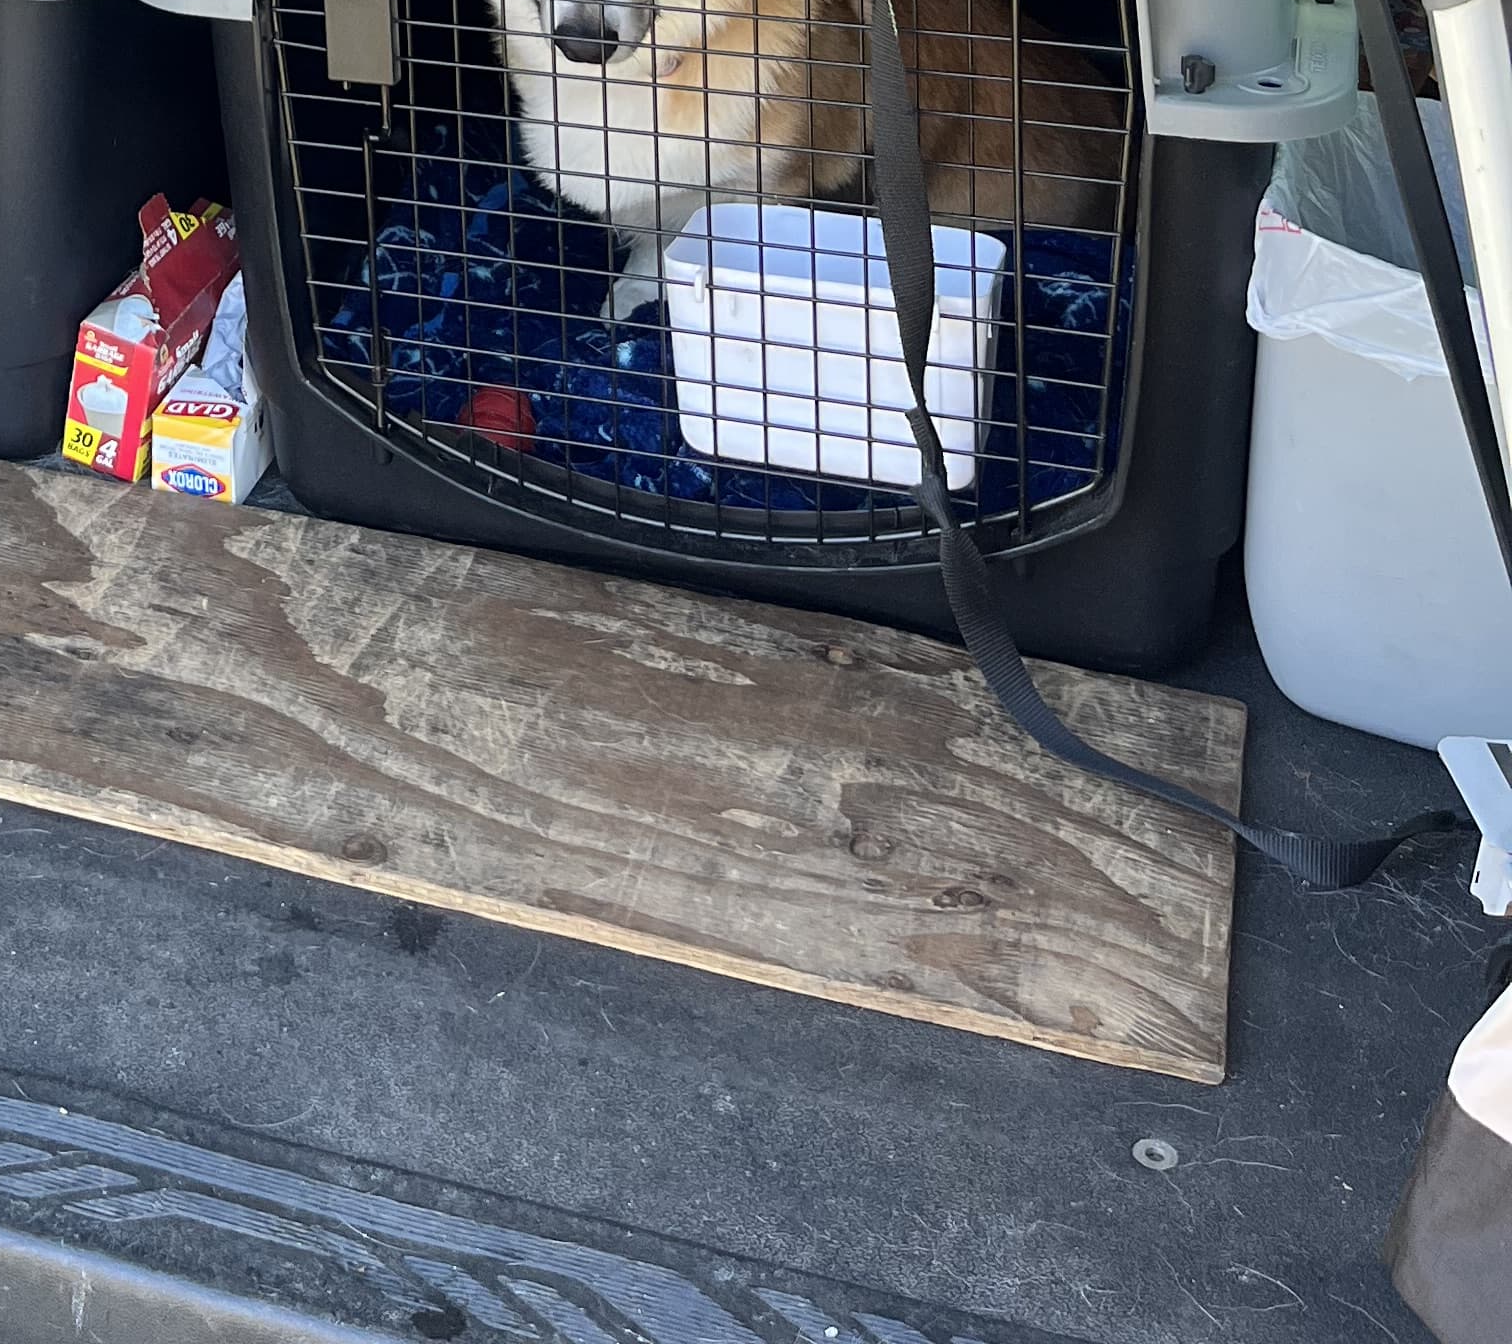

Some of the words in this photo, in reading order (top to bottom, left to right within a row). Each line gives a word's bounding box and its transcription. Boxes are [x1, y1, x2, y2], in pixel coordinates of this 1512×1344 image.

[166, 401, 233, 418] GLAD
[71, 427, 94, 449] 30
[68, 443, 90, 458] BAGS
[99, 439, 118, 459] 4
[96, 455, 114, 468] GAL
[168, 469, 218, 493] CLOROX
